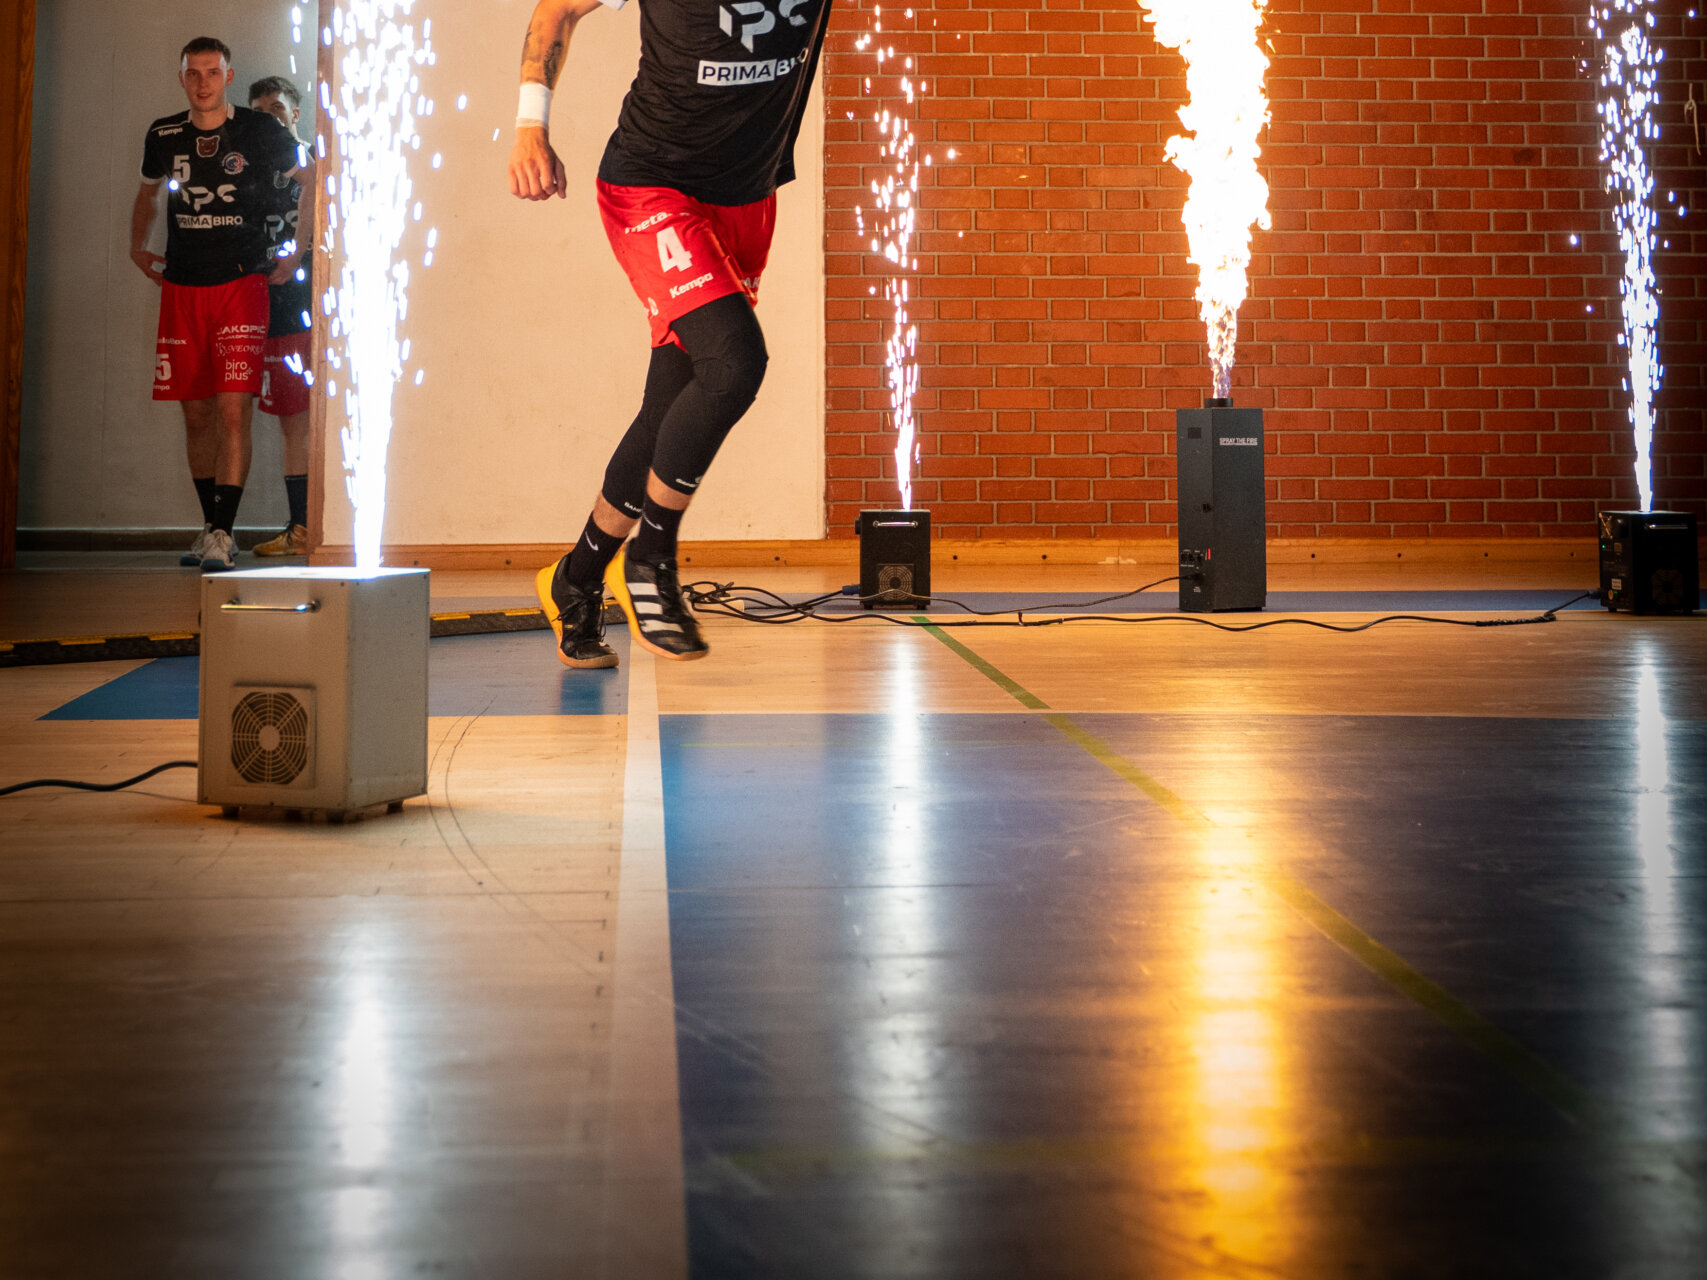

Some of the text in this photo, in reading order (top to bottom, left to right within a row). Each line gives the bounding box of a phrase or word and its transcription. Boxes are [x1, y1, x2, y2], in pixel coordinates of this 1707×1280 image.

[172, 154, 191, 183] 5
[656, 226, 693, 273] 4
[669, 272, 714, 299] Kempa
[155, 353, 172, 381] 5
